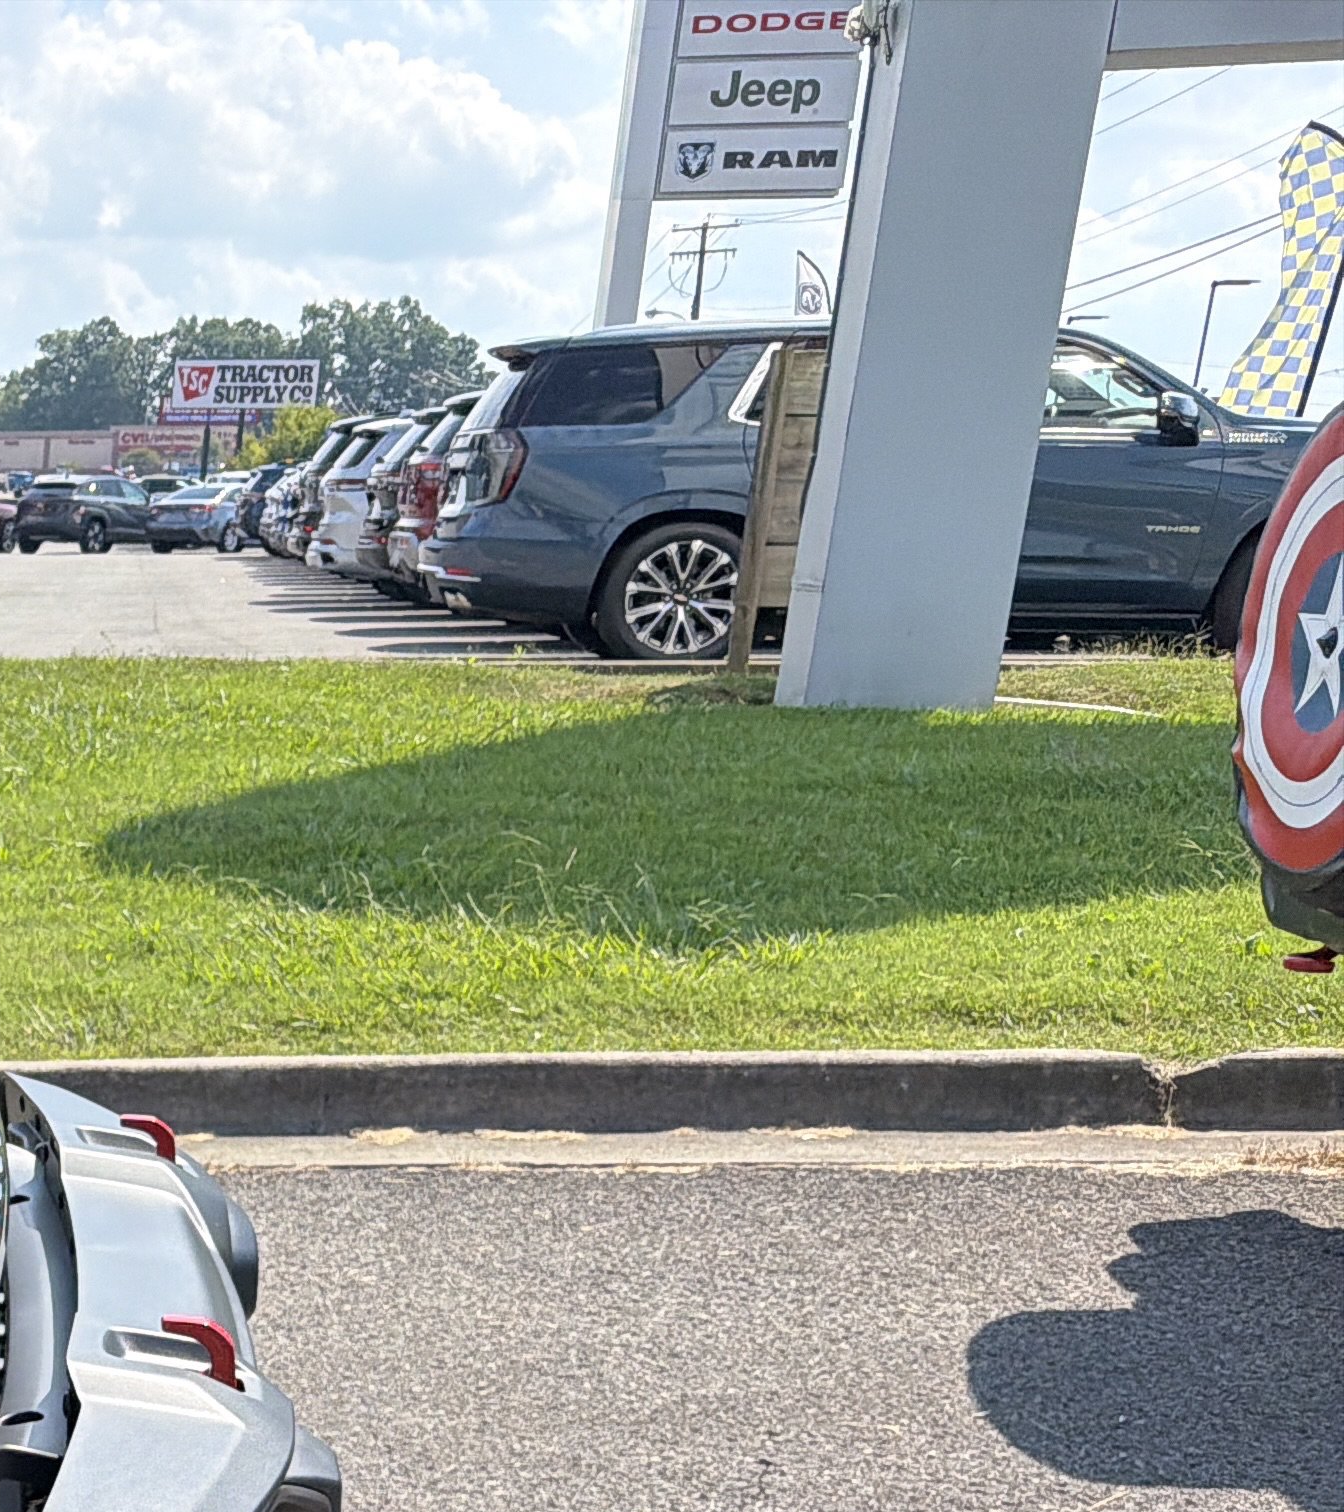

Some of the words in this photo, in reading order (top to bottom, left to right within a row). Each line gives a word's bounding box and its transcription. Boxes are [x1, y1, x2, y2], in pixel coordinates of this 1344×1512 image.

[692, 11, 850, 34] DODGE
[709, 69, 822, 114] Jeep
[722, 149, 839, 170] RAM
[181, 367, 209, 394] TSC
[217, 364, 314, 383] TRACTOR
[212, 384, 288, 404] SUPPLY
